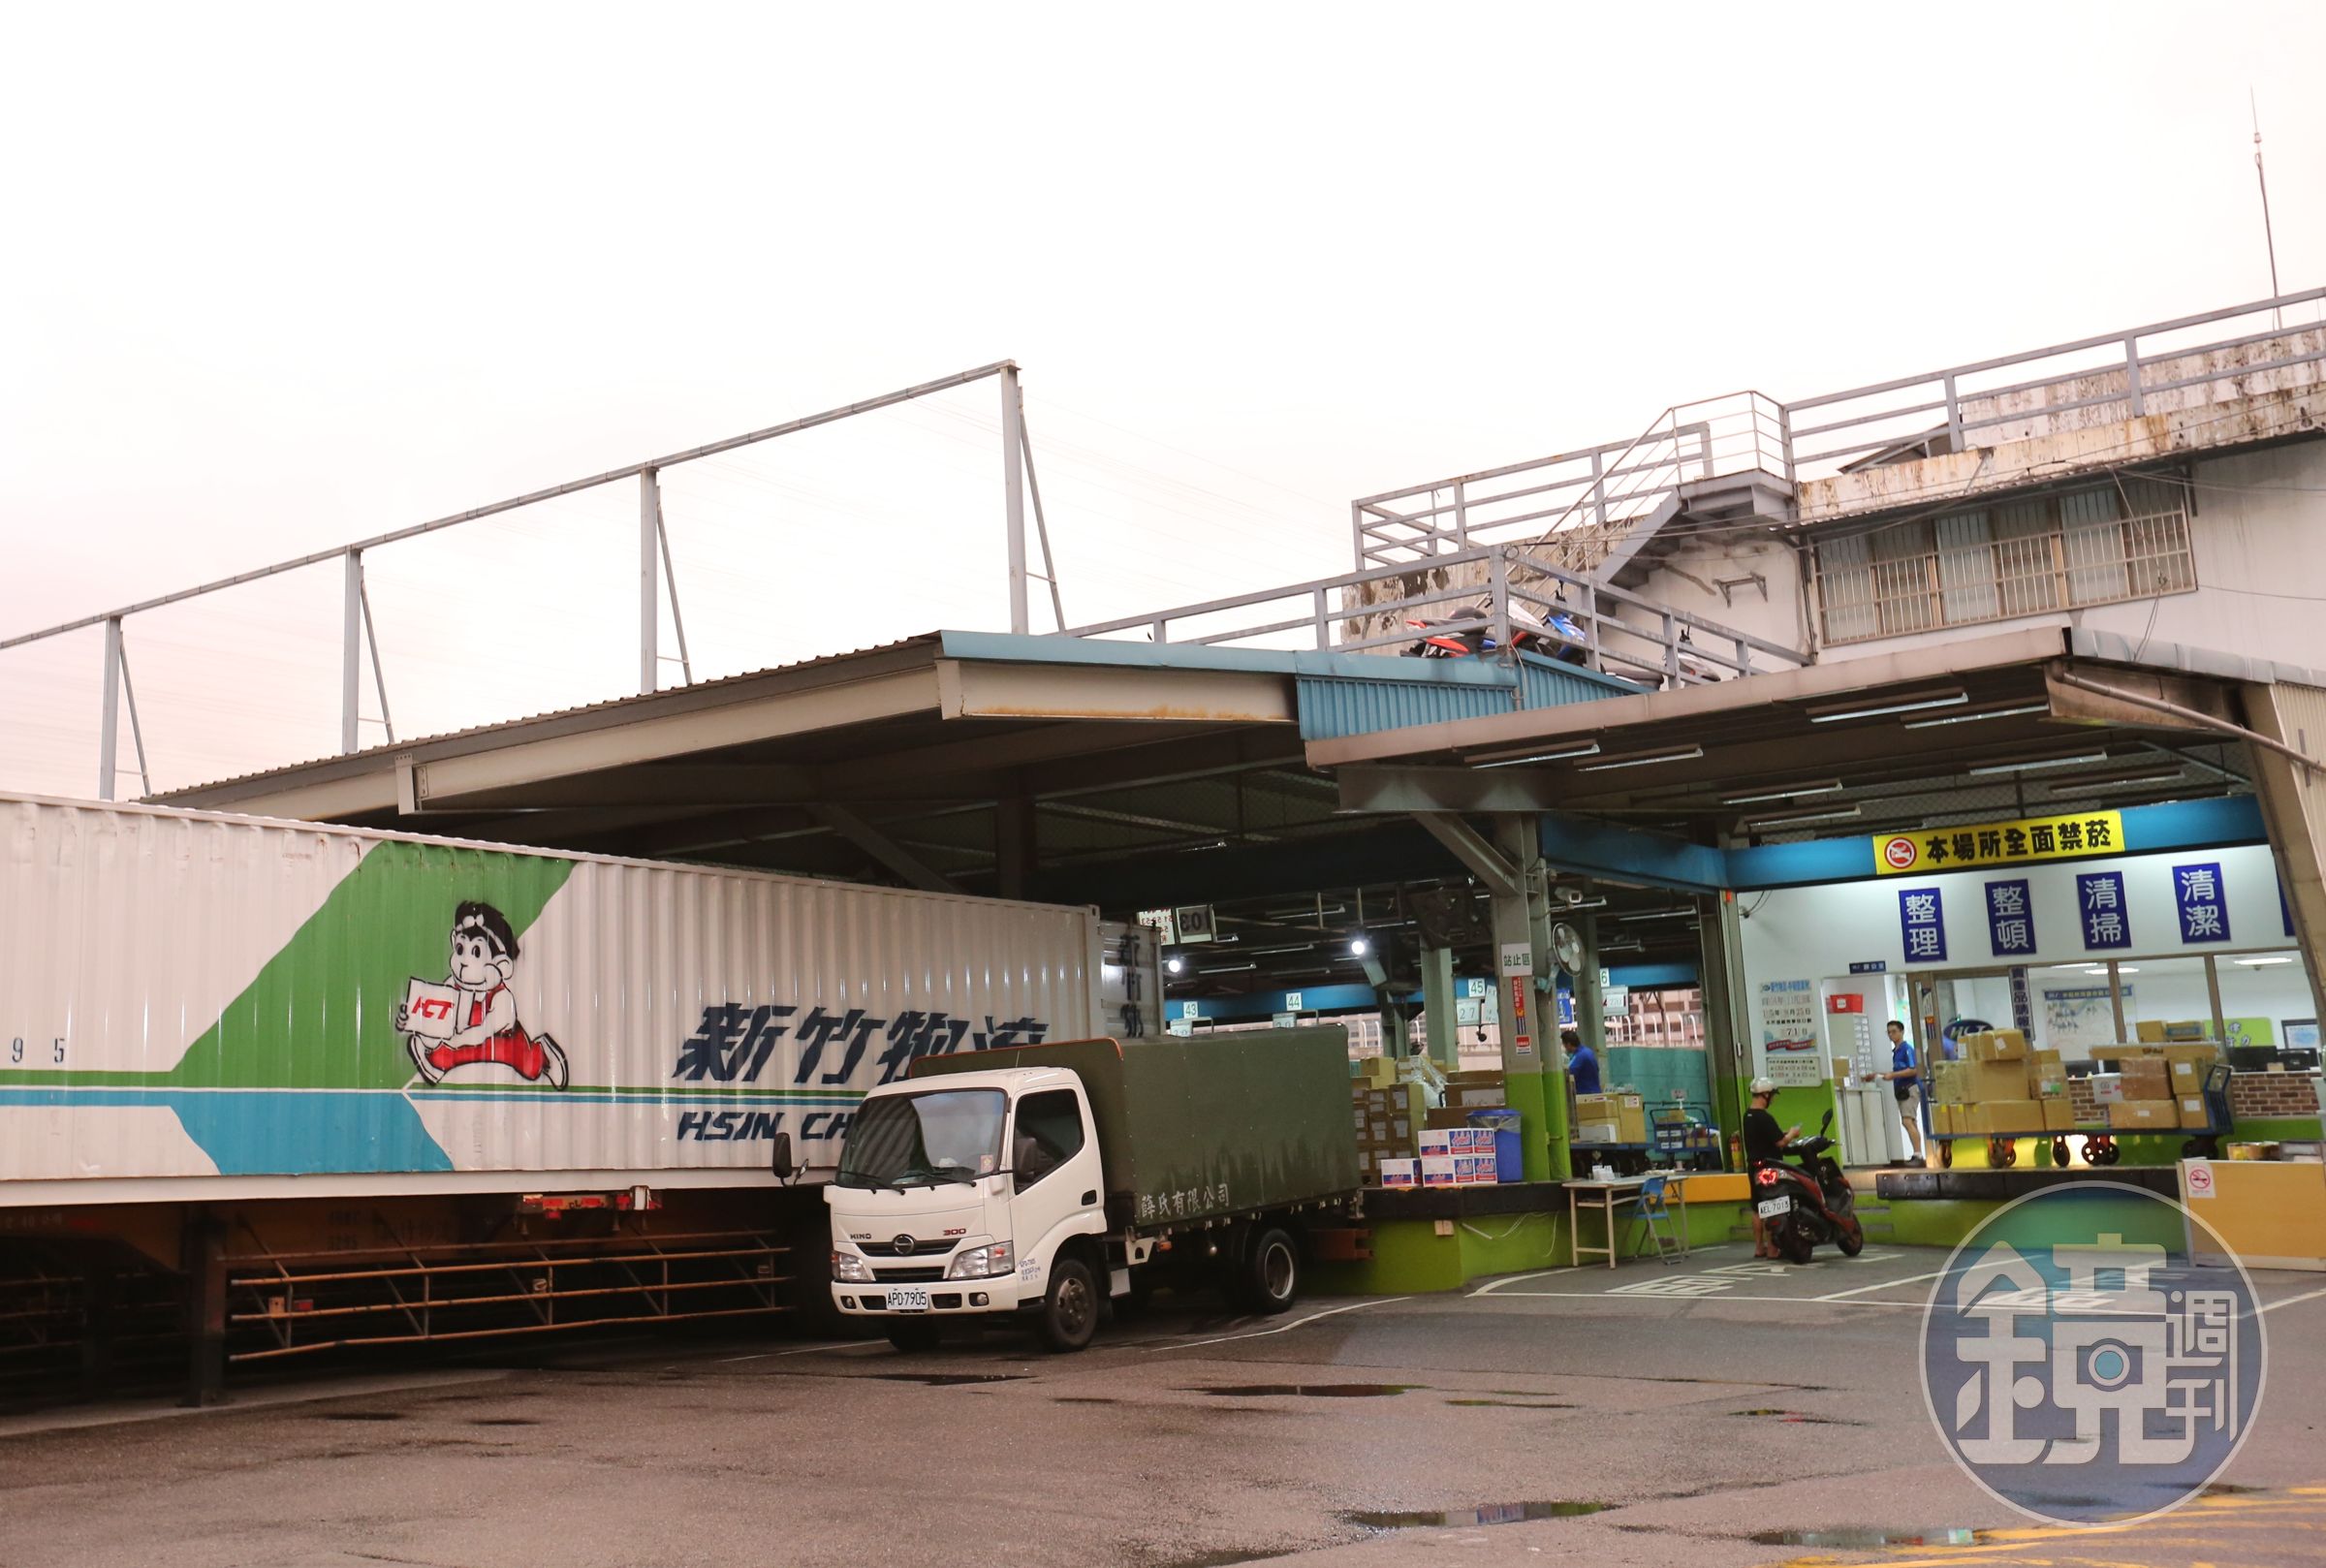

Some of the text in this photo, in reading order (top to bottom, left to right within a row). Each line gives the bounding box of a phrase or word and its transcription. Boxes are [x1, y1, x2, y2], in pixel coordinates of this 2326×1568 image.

[1926, 819, 2112, 863] 本場所全面禁菸
[2085, 877, 2122, 944] 清掃
[2181, 869, 2222, 936] 清潔
[1904, 894, 1940, 956] 整理
[1992, 886, 2030, 950] 整頓
[1287, 994, 1302, 1009] 44
[1470, 980, 1484, 993] 45
[1184, 1003, 1197, 1017] 43
[676, 1111, 785, 1141] HSIN
[942, 1228, 967, 1237] 300
[887, 1291, 927, 1306] APD-7905
